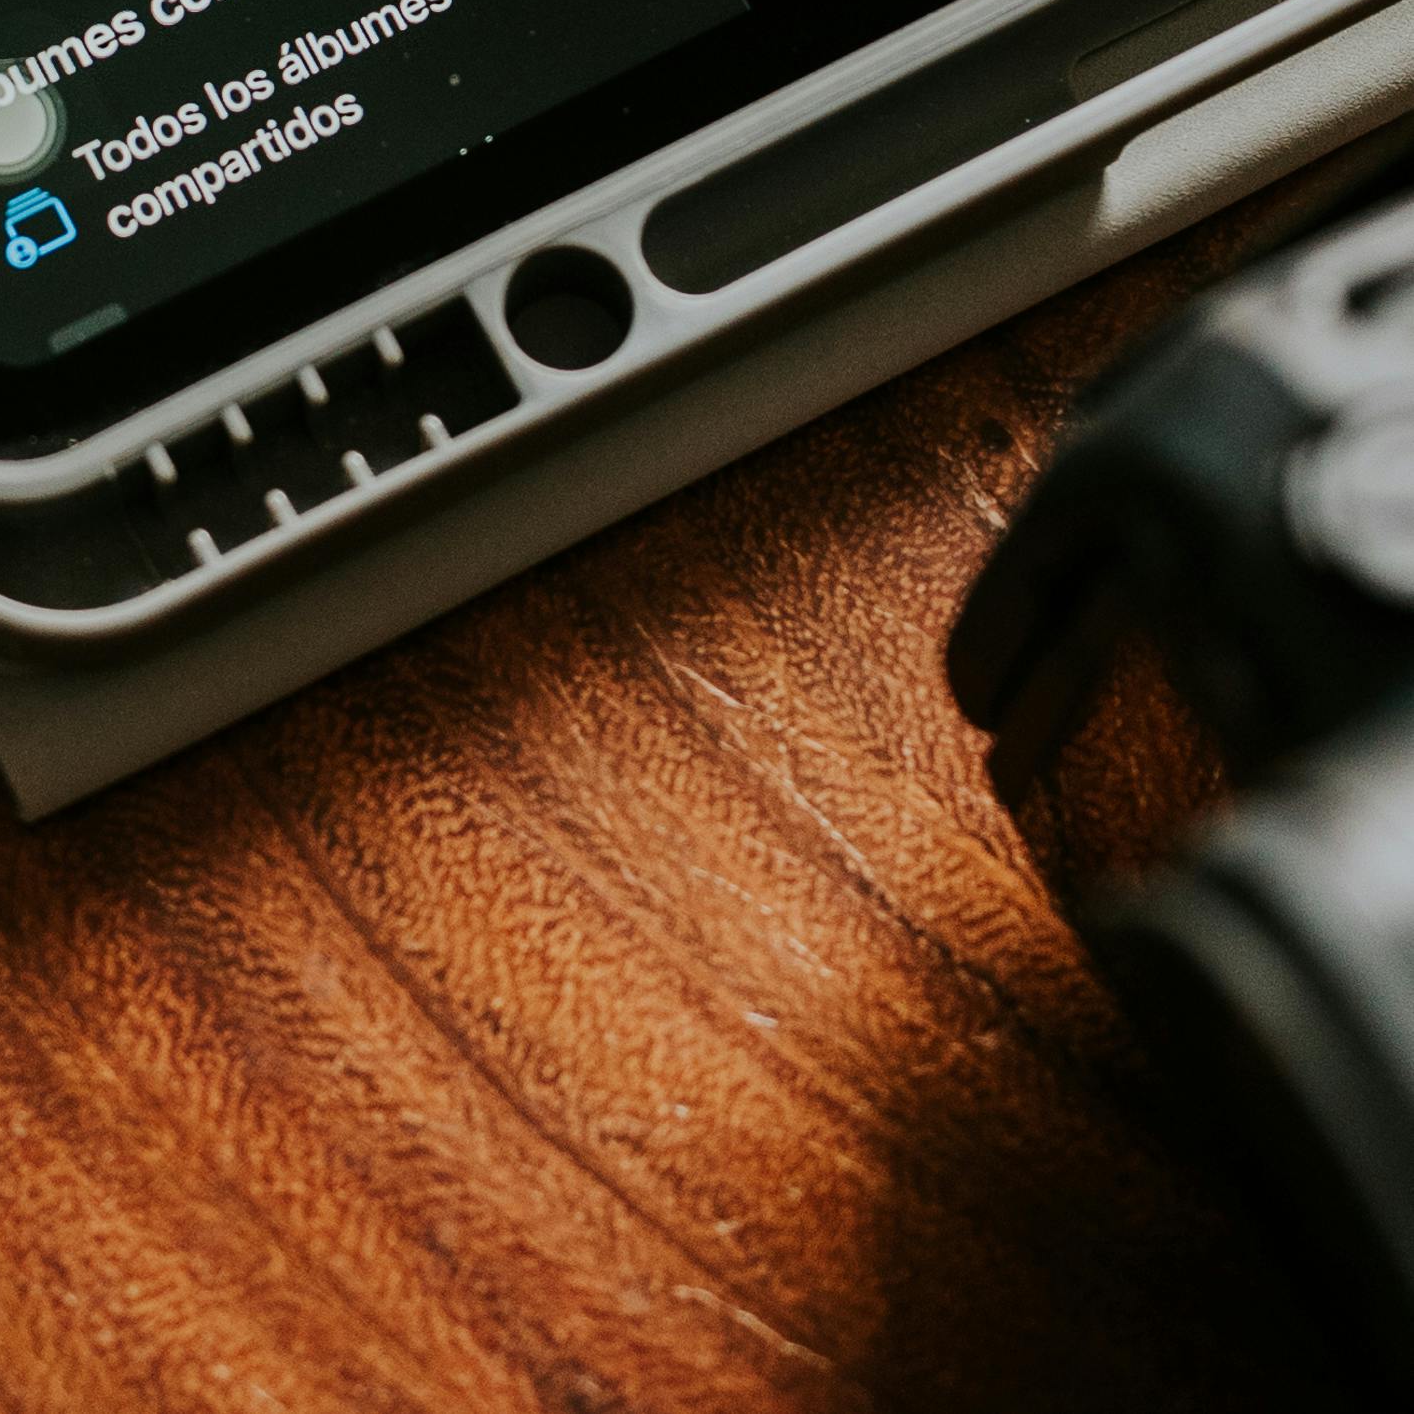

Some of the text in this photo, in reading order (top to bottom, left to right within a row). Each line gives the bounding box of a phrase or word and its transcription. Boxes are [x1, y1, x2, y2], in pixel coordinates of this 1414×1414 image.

[71, 102, 208, 181] Todos
[203, 69, 275, 121] los
[107, 93, 364, 238] compartidos
